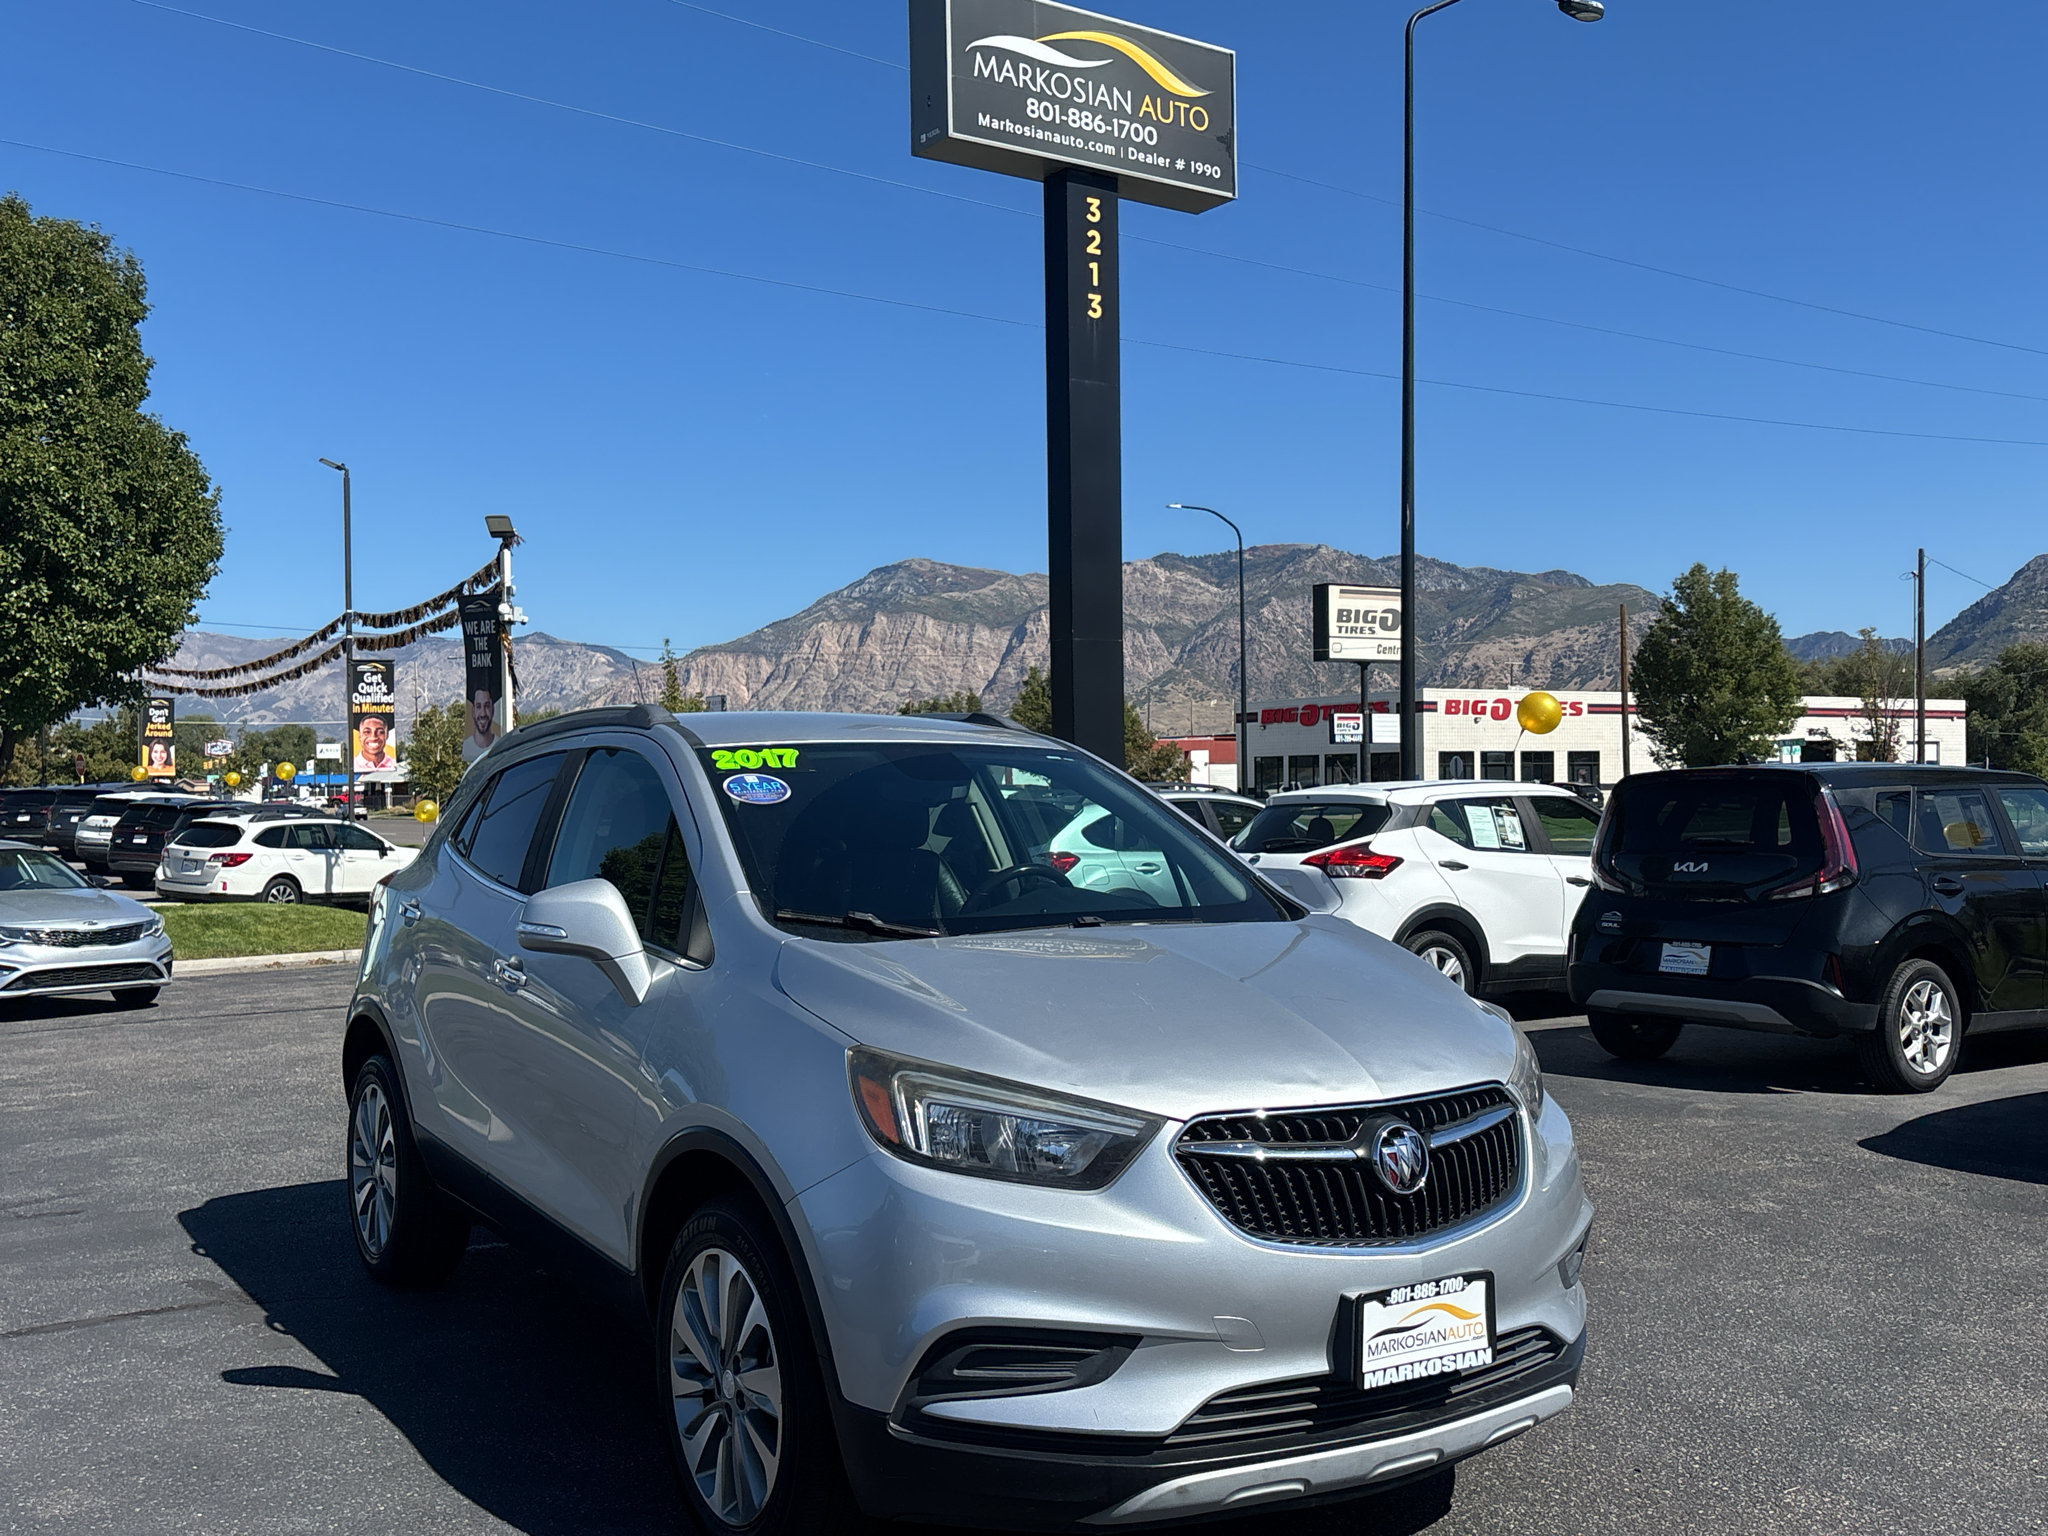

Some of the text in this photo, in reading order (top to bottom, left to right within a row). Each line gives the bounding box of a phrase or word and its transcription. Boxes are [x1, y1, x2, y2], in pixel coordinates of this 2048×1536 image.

[973, 51, 1209, 132] MARKOSIAN AUTO
[1026, 97, 1158, 146] 801-886-1700
[978, 112, 1116, 157] Markosianauto.com
[1128, 146, 1171, 169] Dealer
[1190, 160, 1221, 180] 1990
[1086, 196, 1102, 319] 3213
[1336, 608, 1378, 624] BIG
[464, 619, 496, 635] WE ARE
[1336, 625, 1377, 635] TIRES
[473, 636, 488, 651] THE
[471, 652, 492, 668] BANK
[363, 672, 382, 683] Get
[358, 682, 388, 694] Quick
[352, 692, 394, 704] Qualified
[149, 708, 169, 716] Don't
[361, 703, 395, 713] Minutes
[1261, 707, 1299, 724] BIG
[1300, 704, 1319, 726] O
[1444, 699, 1487, 716] BIG
[1490, 698, 1511, 721] O
[146, 722, 171, 730] Jerked
[152, 715, 166, 723] Get
[711, 748, 799, 770] 2017
[729, 781, 783, 791] 5 YEAR
[1673, 861, 1709, 874] KIA
[674, 1216, 718, 1258] SAILUN
[1390, 1276, 1463, 1305] 801-886-1700
[1363, 1347, 1493, 1390] MARKOSIAN
